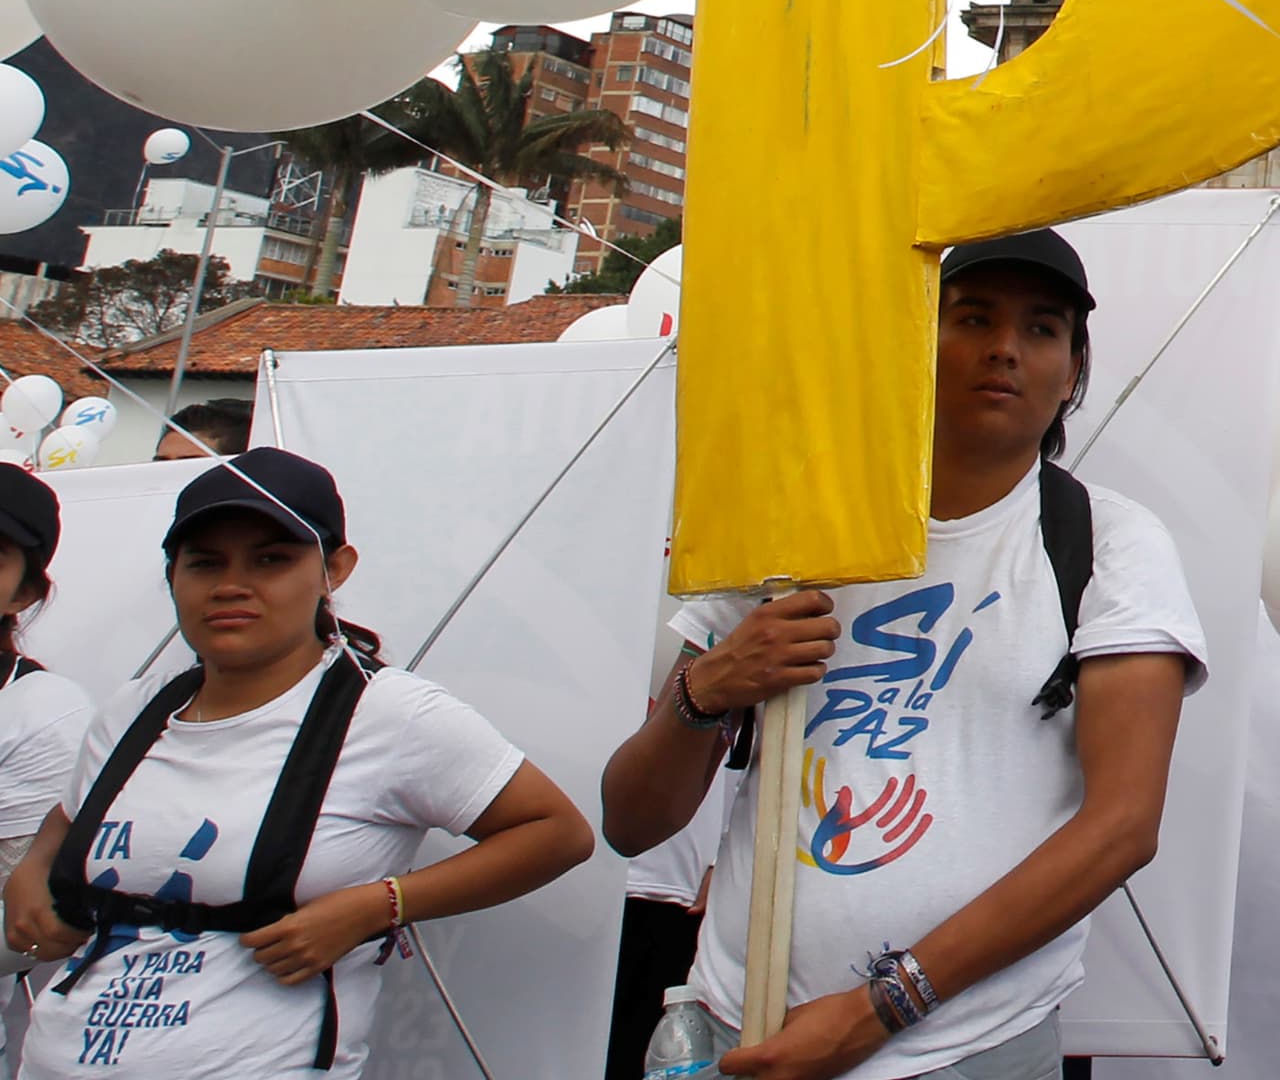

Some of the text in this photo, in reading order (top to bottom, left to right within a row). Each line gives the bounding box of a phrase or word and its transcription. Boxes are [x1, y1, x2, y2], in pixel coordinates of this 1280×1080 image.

[877, 680, 933, 710] a la
[804, 689, 929, 759] PAZ
[122, 951, 206, 977] Y PARA
[101, 977, 164, 1000] ESTA
[88, 1000, 190, 1028] GUERRA
[79, 1028, 130, 1064] YA!
